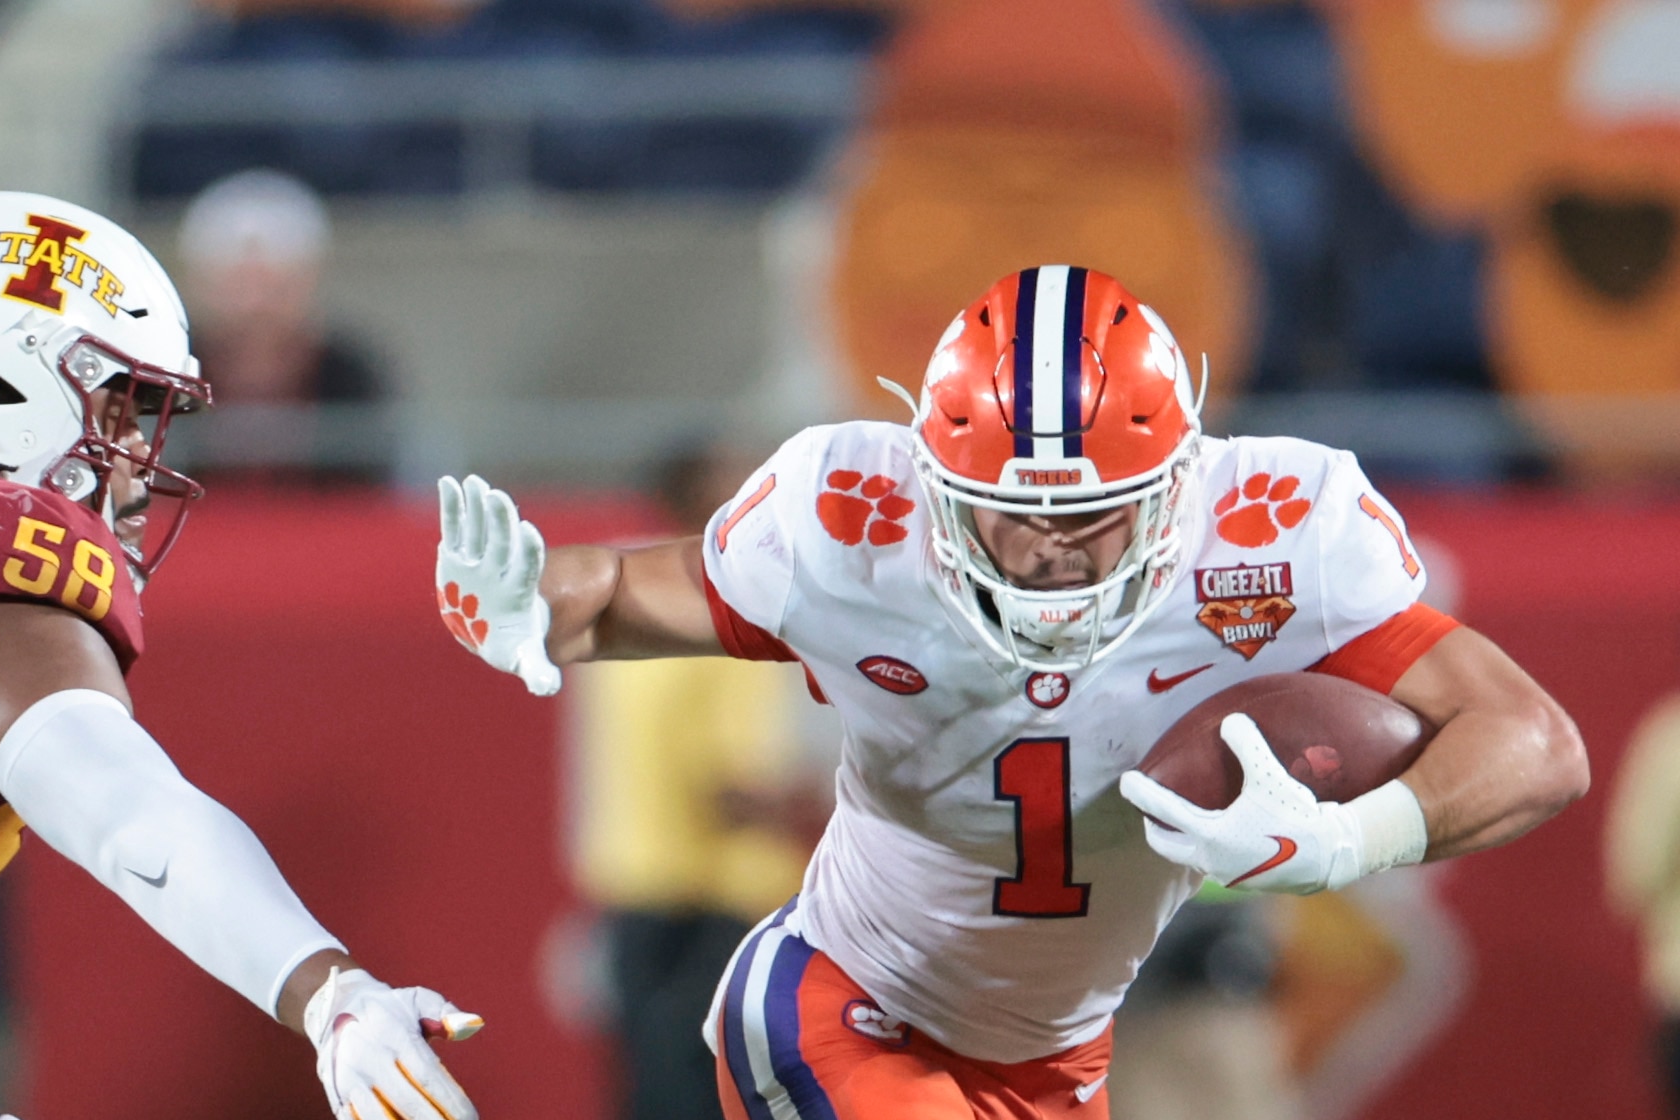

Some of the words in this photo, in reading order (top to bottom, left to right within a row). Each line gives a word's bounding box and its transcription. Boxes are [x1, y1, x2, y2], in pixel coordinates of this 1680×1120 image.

[1015, 468, 1082, 486] TIGERS
[1357, 492, 1421, 581] 1
[1, 515, 116, 621] 58
[1039, 609, 1065, 623] ALL
[1222, 621, 1276, 645] BOWL
[866, 662, 920, 686] ACC
[991, 736, 1092, 918] 1
